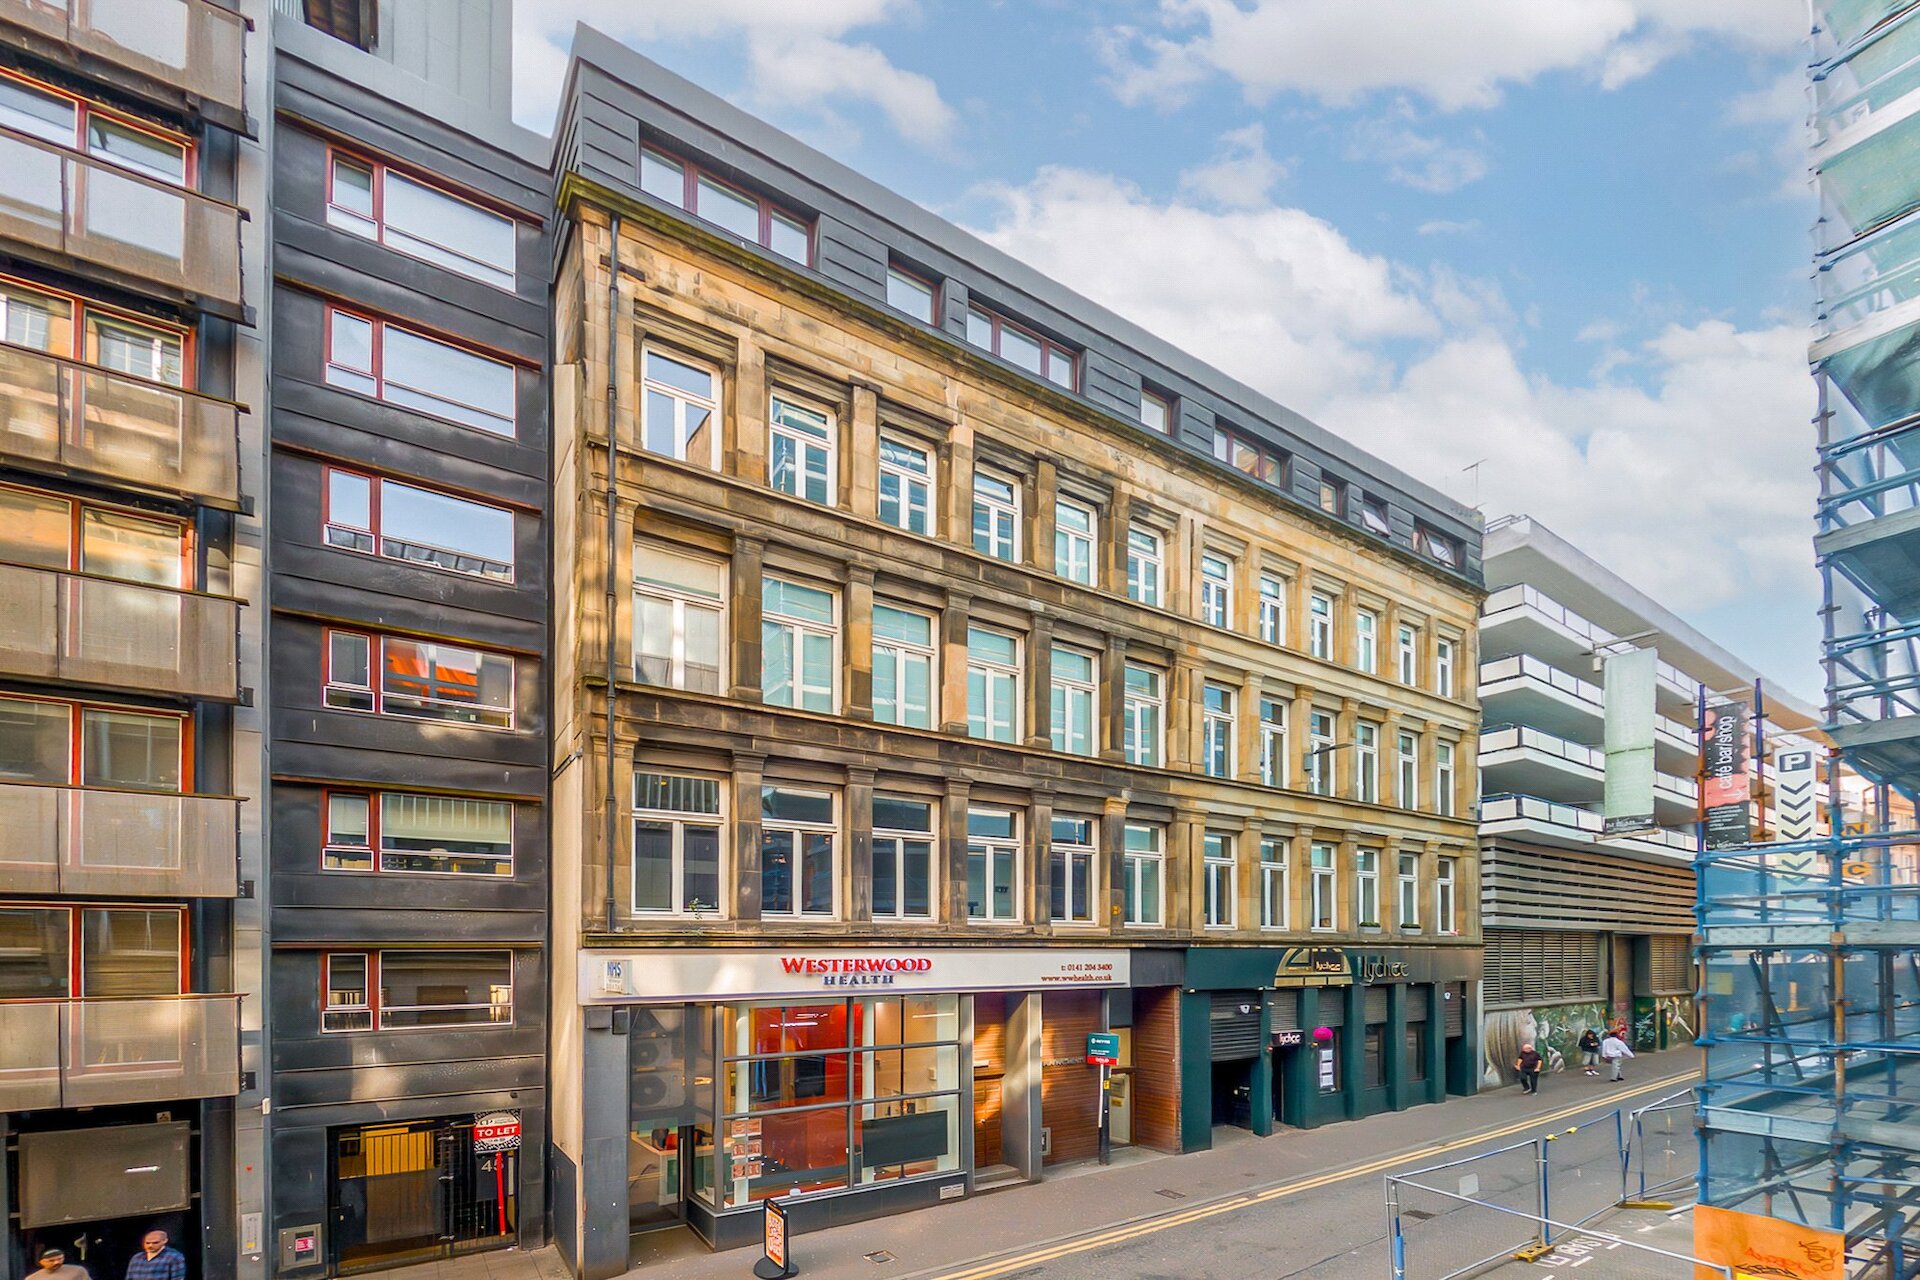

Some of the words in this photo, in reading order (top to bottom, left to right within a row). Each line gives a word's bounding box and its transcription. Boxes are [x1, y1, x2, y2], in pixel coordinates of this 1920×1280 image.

[1715, 716, 1736, 765] bar/shop
[1784, 754, 1806, 770] P
[1715, 766, 1733, 790] café
[606, 961, 622, 977] NHS
[1363, 955, 1409, 983] lychee
[824, 975, 894, 986] HEALTH
[1041, 974, 1113, 982] www.wwhealth.co.uk
[1279, 1033, 1301, 1045] lychee
[477, 1129, 494, 1137] TO
[496, 1126, 518, 1136] LET
